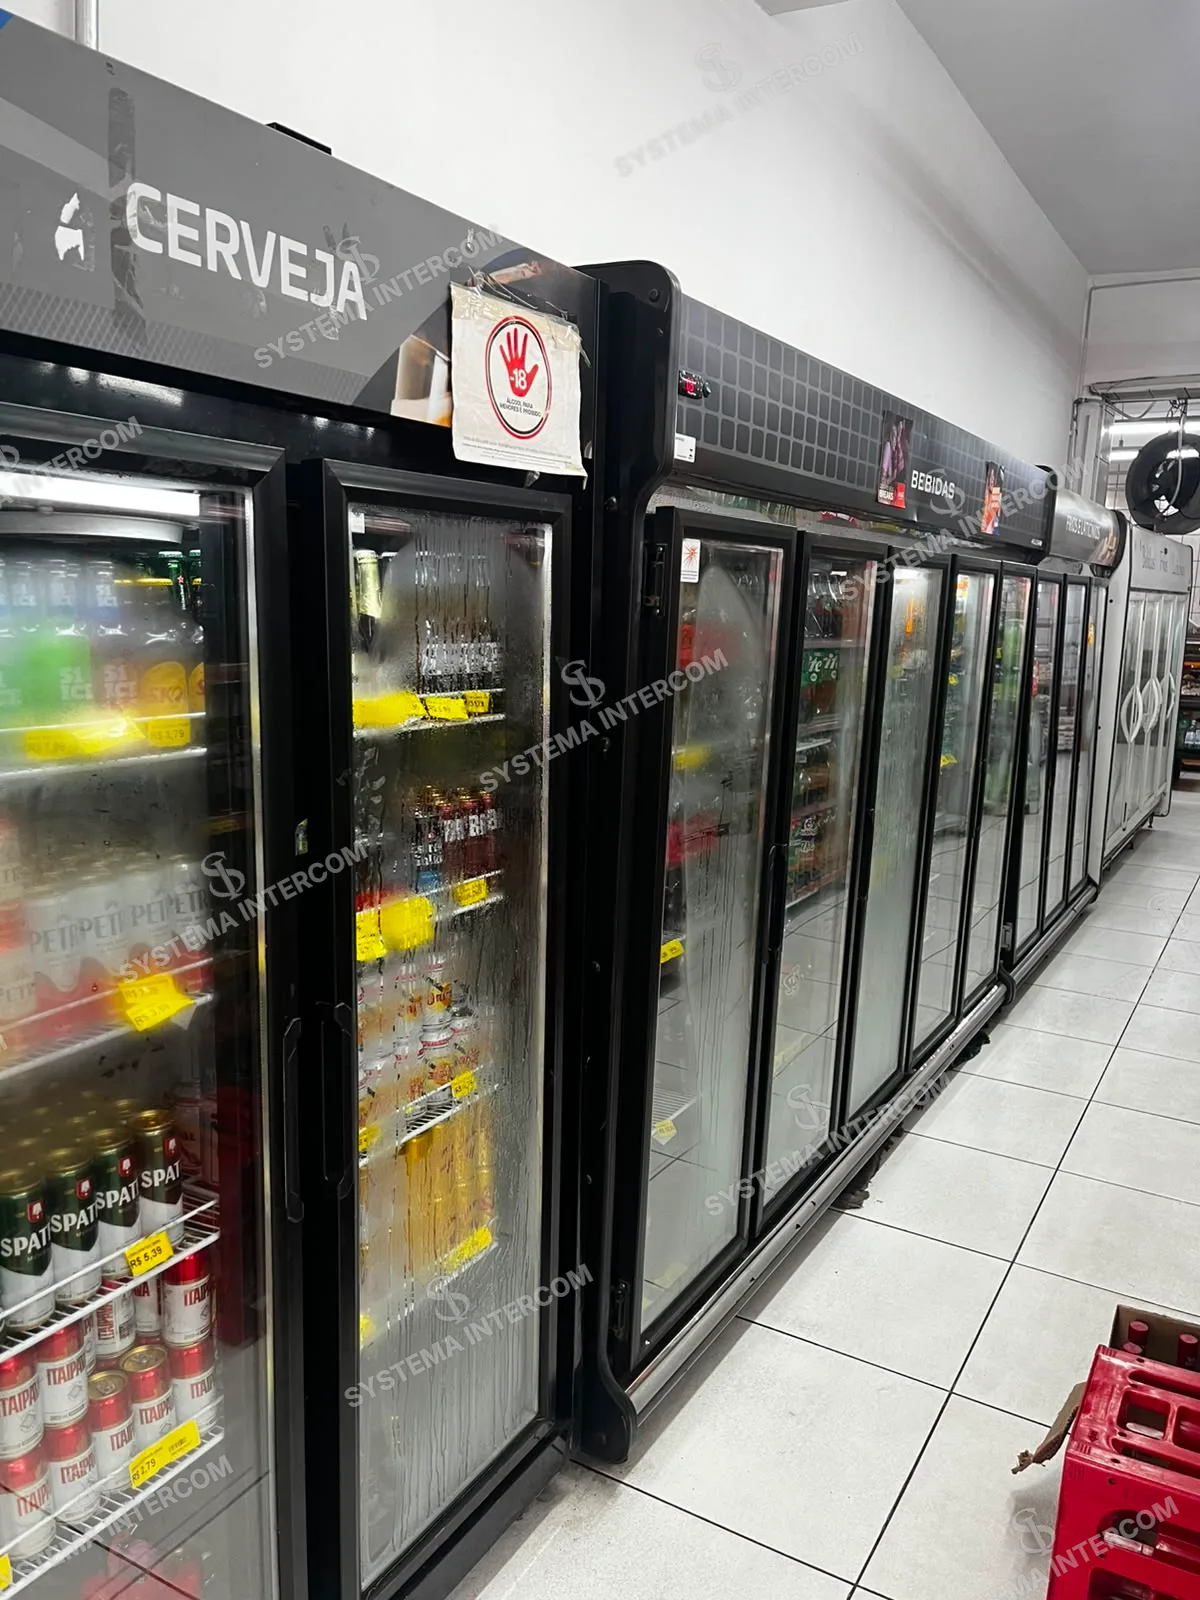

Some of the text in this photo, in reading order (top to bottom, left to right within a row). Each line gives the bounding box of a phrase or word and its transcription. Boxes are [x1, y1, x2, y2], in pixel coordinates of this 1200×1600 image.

[125, 181, 368, 322] CERVEJA
[510, 368, 527, 390] -18
[911, 470, 955, 499] BEBIDAS
[141, 1160, 181, 1188] SPAT
[130, 1246, 163, 1269] R$ 5,39
